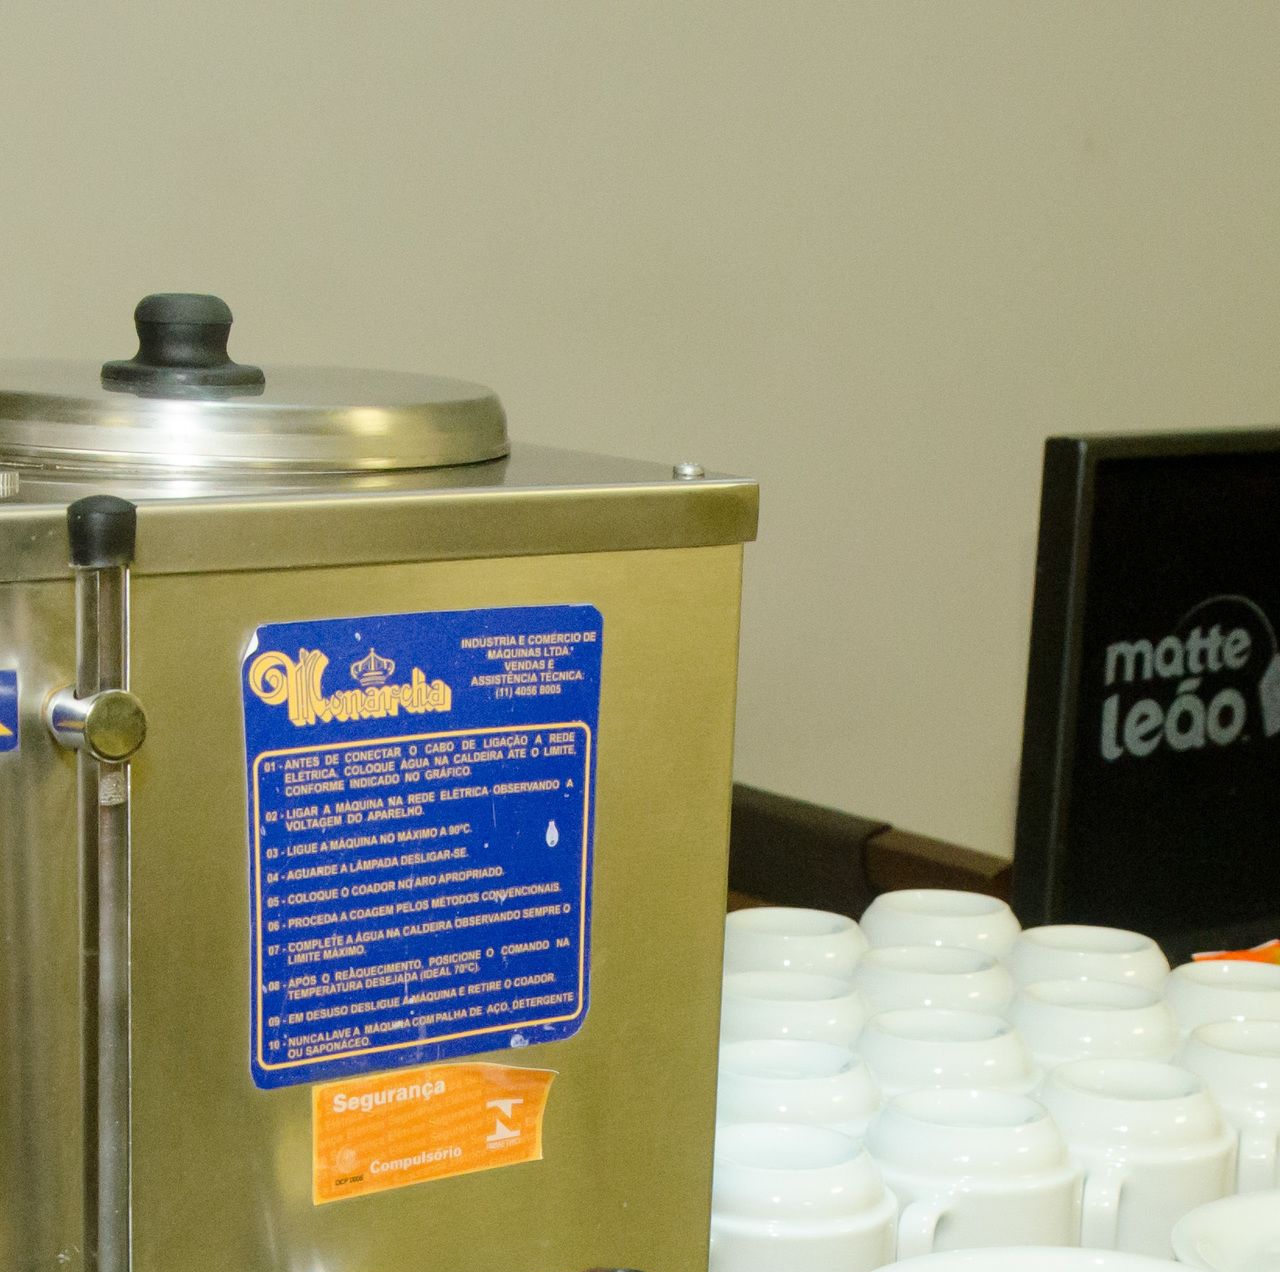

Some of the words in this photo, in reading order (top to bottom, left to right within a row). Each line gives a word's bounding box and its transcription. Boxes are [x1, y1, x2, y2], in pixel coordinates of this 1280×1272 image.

[519, 635, 525, 645] E
[583, 631, 596, 642] DE
[504, 660, 545, 670] VENDAS
[548, 660, 554, 668] E
[1104, 624, 1252, 686] matte
[249, 648, 451, 726] Monarcha
[471, 670, 537, 686] ASSISTÊNCIA
[496, 687, 512, 699] (11)
[285, 756, 320, 770] ANTES
[325, 754, 339, 765] DE
[345, 747, 401, 763] CONECTAR
[409, 745, 417, 756] O
[425, 742, 454, 754] CABO
[462, 740, 476, 751] DE
[535, 735, 542, 745] A
[550, 732, 576, 744] REDE
[344, 761, 395, 777] COLOQUE
[435, 756, 449, 766] NA
[454, 751, 503, 764] CALDEIRA
[532, 748, 539, 758] O
[285, 780, 344, 797] CONFORME
[350, 774, 400, 790] INDICADO
[405, 772, 420, 783] NO
[266, 811, 277, 822] 02
[286, 806, 318, 820] LIGAR
[323, 804, 330, 815] A
[389, 796, 403, 807] NA
[408, 792, 435, 804] REDE
[493, 780, 560, 796] OBSERVANDO
[567, 779, 574, 788] A
[286, 815, 342, 832] VOLTAGEM
[348, 813, 362, 825] DO
[367, 806, 425, 822] APARELHO.
[266, 848, 278, 860] 03
[287, 843, 317, 857] LIGUE
[321, 842, 328, 852] A
[380, 833, 395, 844] NO
[440, 827, 448, 837] A
[267, 872, 279, 884] 04
[287, 864, 338, 881] AGUARDE
[341, 863, 348, 874] A
[267, 897, 279, 908] 05
[288, 889, 339, 905] COLOQUE
[342, 888, 349, 898] O
[352, 881, 395, 897] COADOR
[398, 879, 412, 891] NO
[415, 876, 437, 888] ARO
[268, 945, 280, 956] 07
[288, 935, 344, 953] COMPLETE
[346, 933, 355, 945] A
[387, 927, 400, 939] NA
[403, 920, 452, 936] CALDEIRA
[455, 910, 521, 929] OBSERVANDO
[523, 905, 561, 919] SEMPRE
[563, 903, 571, 913] O
[288, 913, 338, 930] PROCEDA
[340, 912, 347, 922] A
[350, 905, 394, 921] COAGEM
[397, 900, 429, 914] PELOS
[269, 981, 280, 992] 08
[322, 973, 330, 984] O
[429, 950, 481, 967] POSICIONE
[486, 948, 494, 959] O
[501, 940, 550, 956] COMANDO
[557, 937, 570, 948] NA
[288, 951, 320, 966] LIMITE
[288, 980, 363, 1001] TEMPERATURA
[366, 971, 418, 989] DESEJADA
[420, 966, 452, 980] (IDEAL
[269, 1016, 280, 1028] 09
[288, 1012, 303, 1024] EM
[306, 1005, 349, 1021] DESUSO
[351, 997, 400, 1014] DESLIGUE
[459, 986, 465, 997] E
[468, 980, 502, 995] RETIRE
[504, 979, 512, 990] O
[268, 1040, 280, 1051] 10
[288, 1032, 326, 1048] NUNCA
[326, 1028, 351, 1041] LAVE
[353, 1026, 361, 1037] A
[412, 1014, 435, 1027] COM
[436, 1009, 467, 1023] PALHA
[470, 1006, 482, 1017] DE
[513, 992, 574, 1010] DETERGENTE
[288, 1047, 303, 1059] OU
[333, 1080, 446, 1113] Segurança
[370, 1146, 462, 1174] Compulsório
